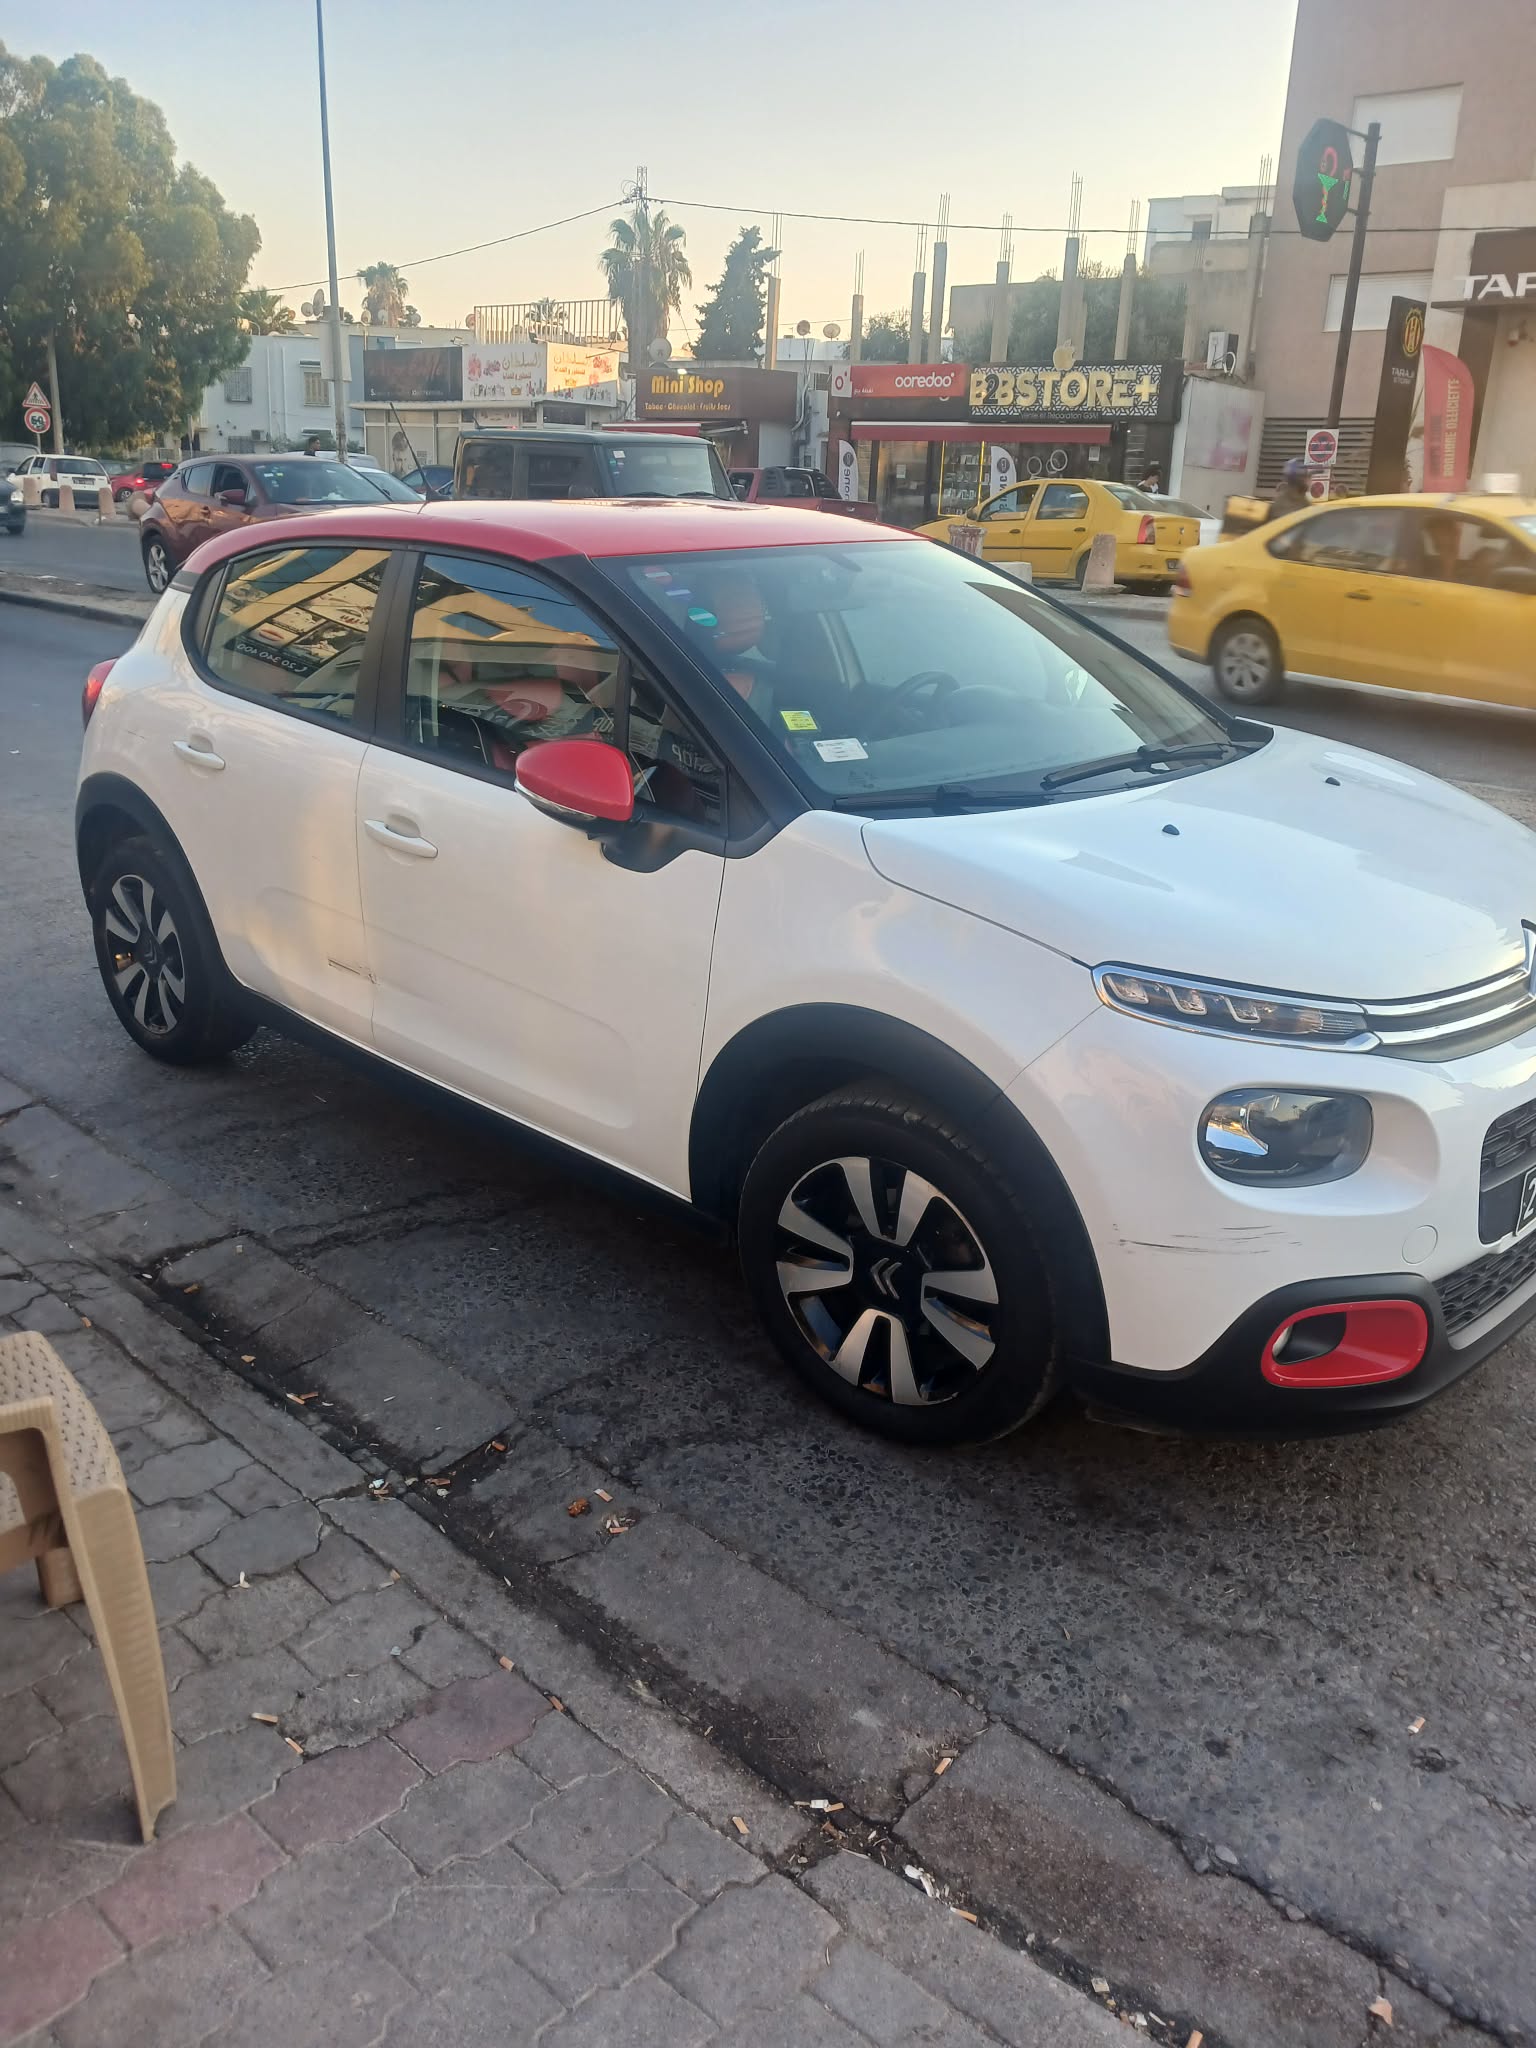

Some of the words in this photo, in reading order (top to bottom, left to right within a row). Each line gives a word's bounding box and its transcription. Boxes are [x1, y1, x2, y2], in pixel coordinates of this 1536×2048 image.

[651, 375, 684, 394] Mini
[687, 375, 725, 398] Shop
[894, 371, 955, 388] ooredoo
